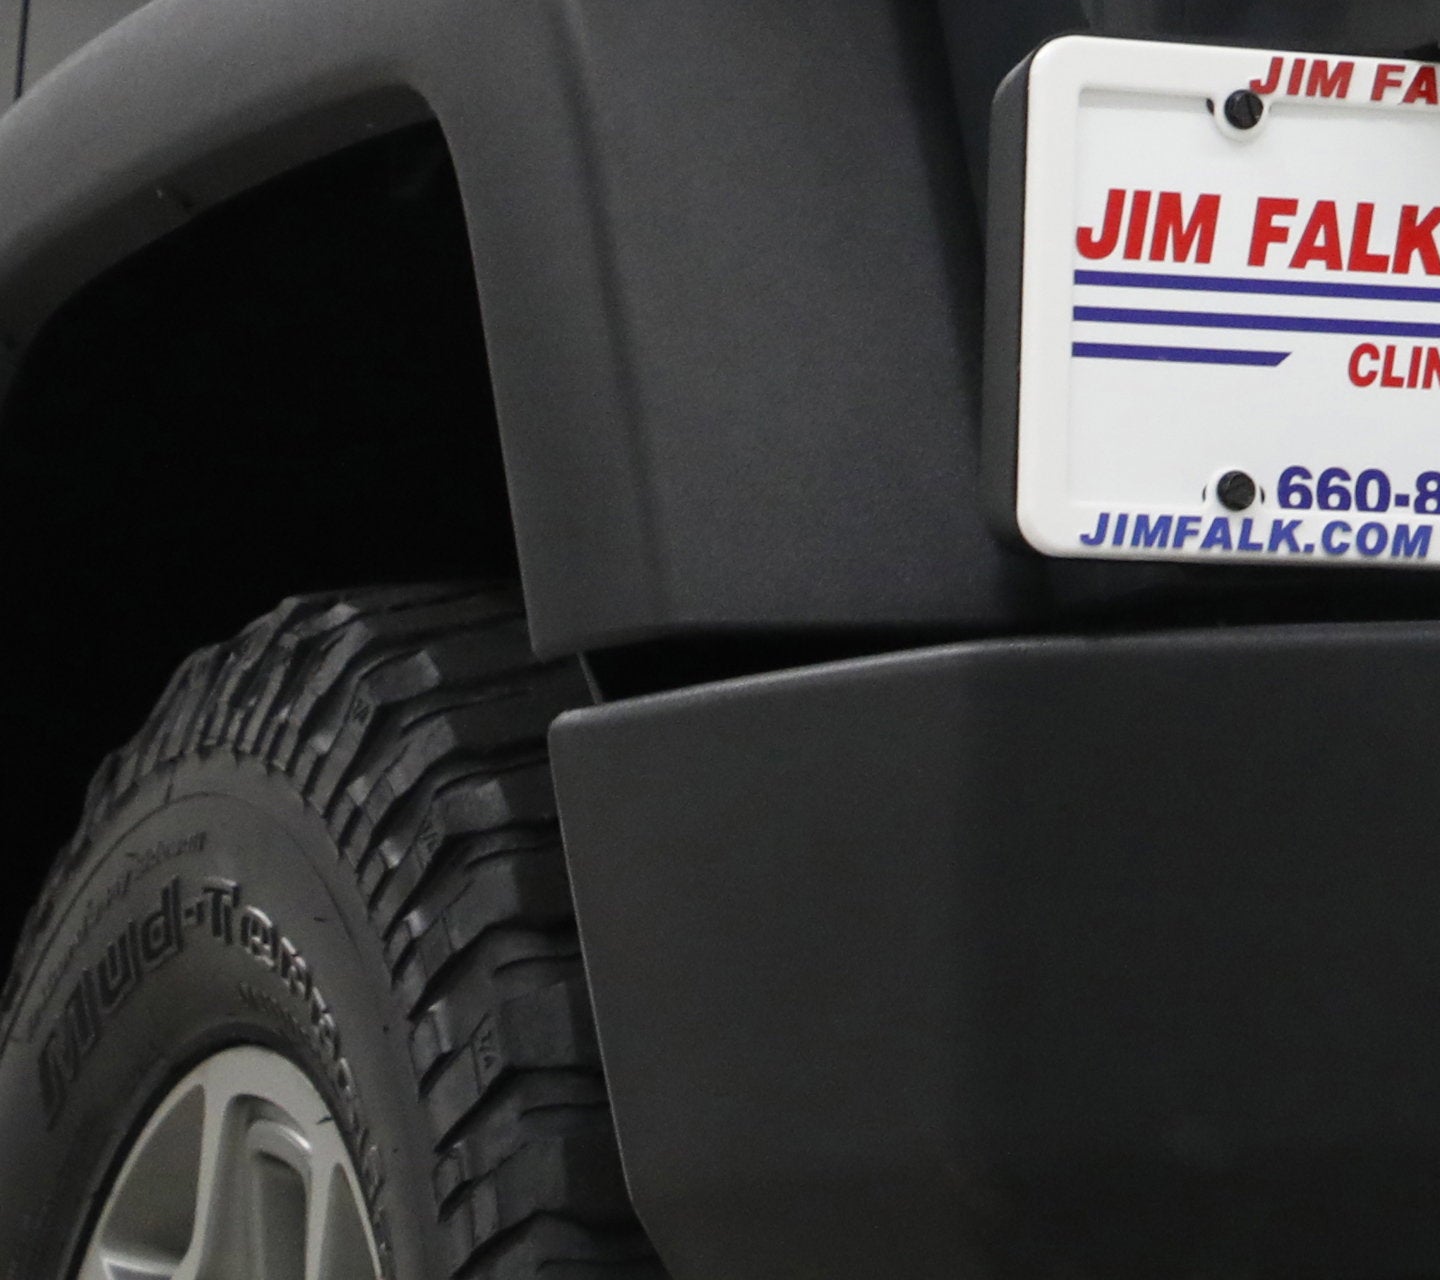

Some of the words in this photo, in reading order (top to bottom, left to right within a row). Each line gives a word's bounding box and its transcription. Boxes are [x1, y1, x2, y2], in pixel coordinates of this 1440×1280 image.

[1250, 57, 1355, 99] JIM
[1076, 188, 1221, 264] JIM
[1080, 513, 1432, 557] JIMFALK.COM
